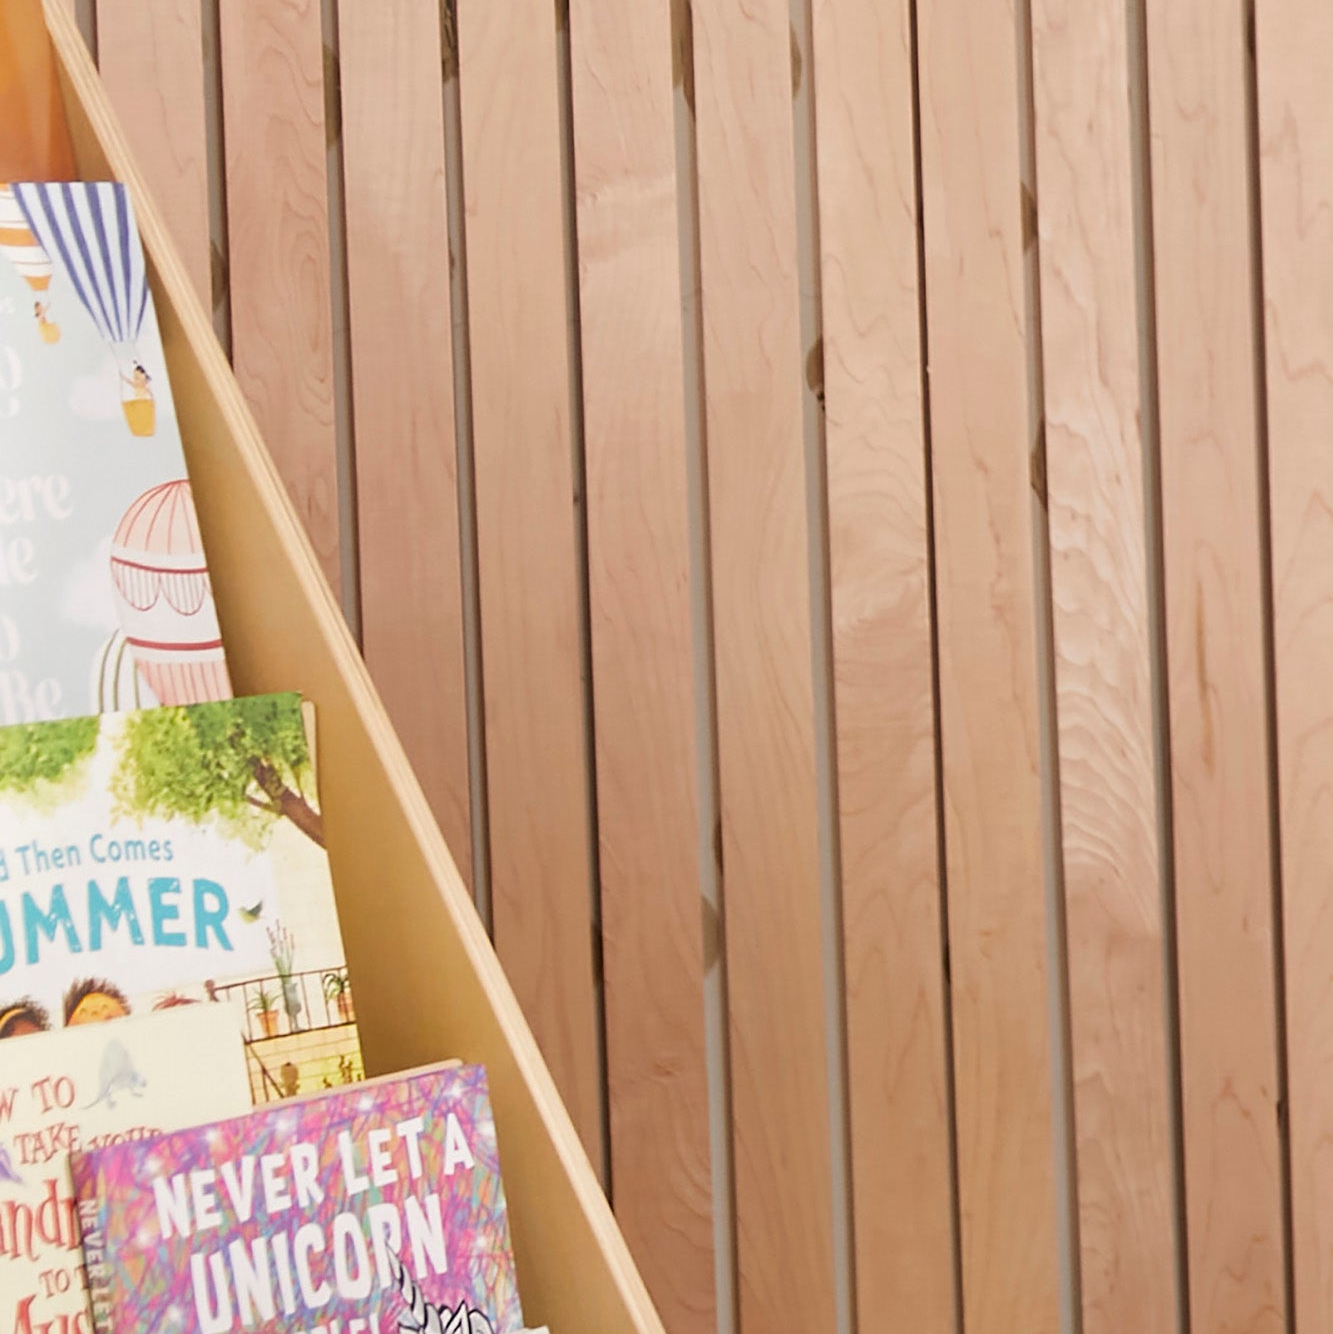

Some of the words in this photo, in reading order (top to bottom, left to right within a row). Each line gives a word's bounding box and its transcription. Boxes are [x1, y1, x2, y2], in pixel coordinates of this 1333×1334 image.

[15, 839, 81, 876] Then
[89, 833, 174, 864] Comes
[31, 1075, 76, 1114] TO
[14, 1122, 82, 1165] TAKE
[152, 1137, 326, 1241] NEVER
[337, 1118, 427, 1194] LET
[443, 1112, 476, 1175] A
[79, 1199, 107, 1280] NEVER
[39, 1268, 71, 1298] TO
